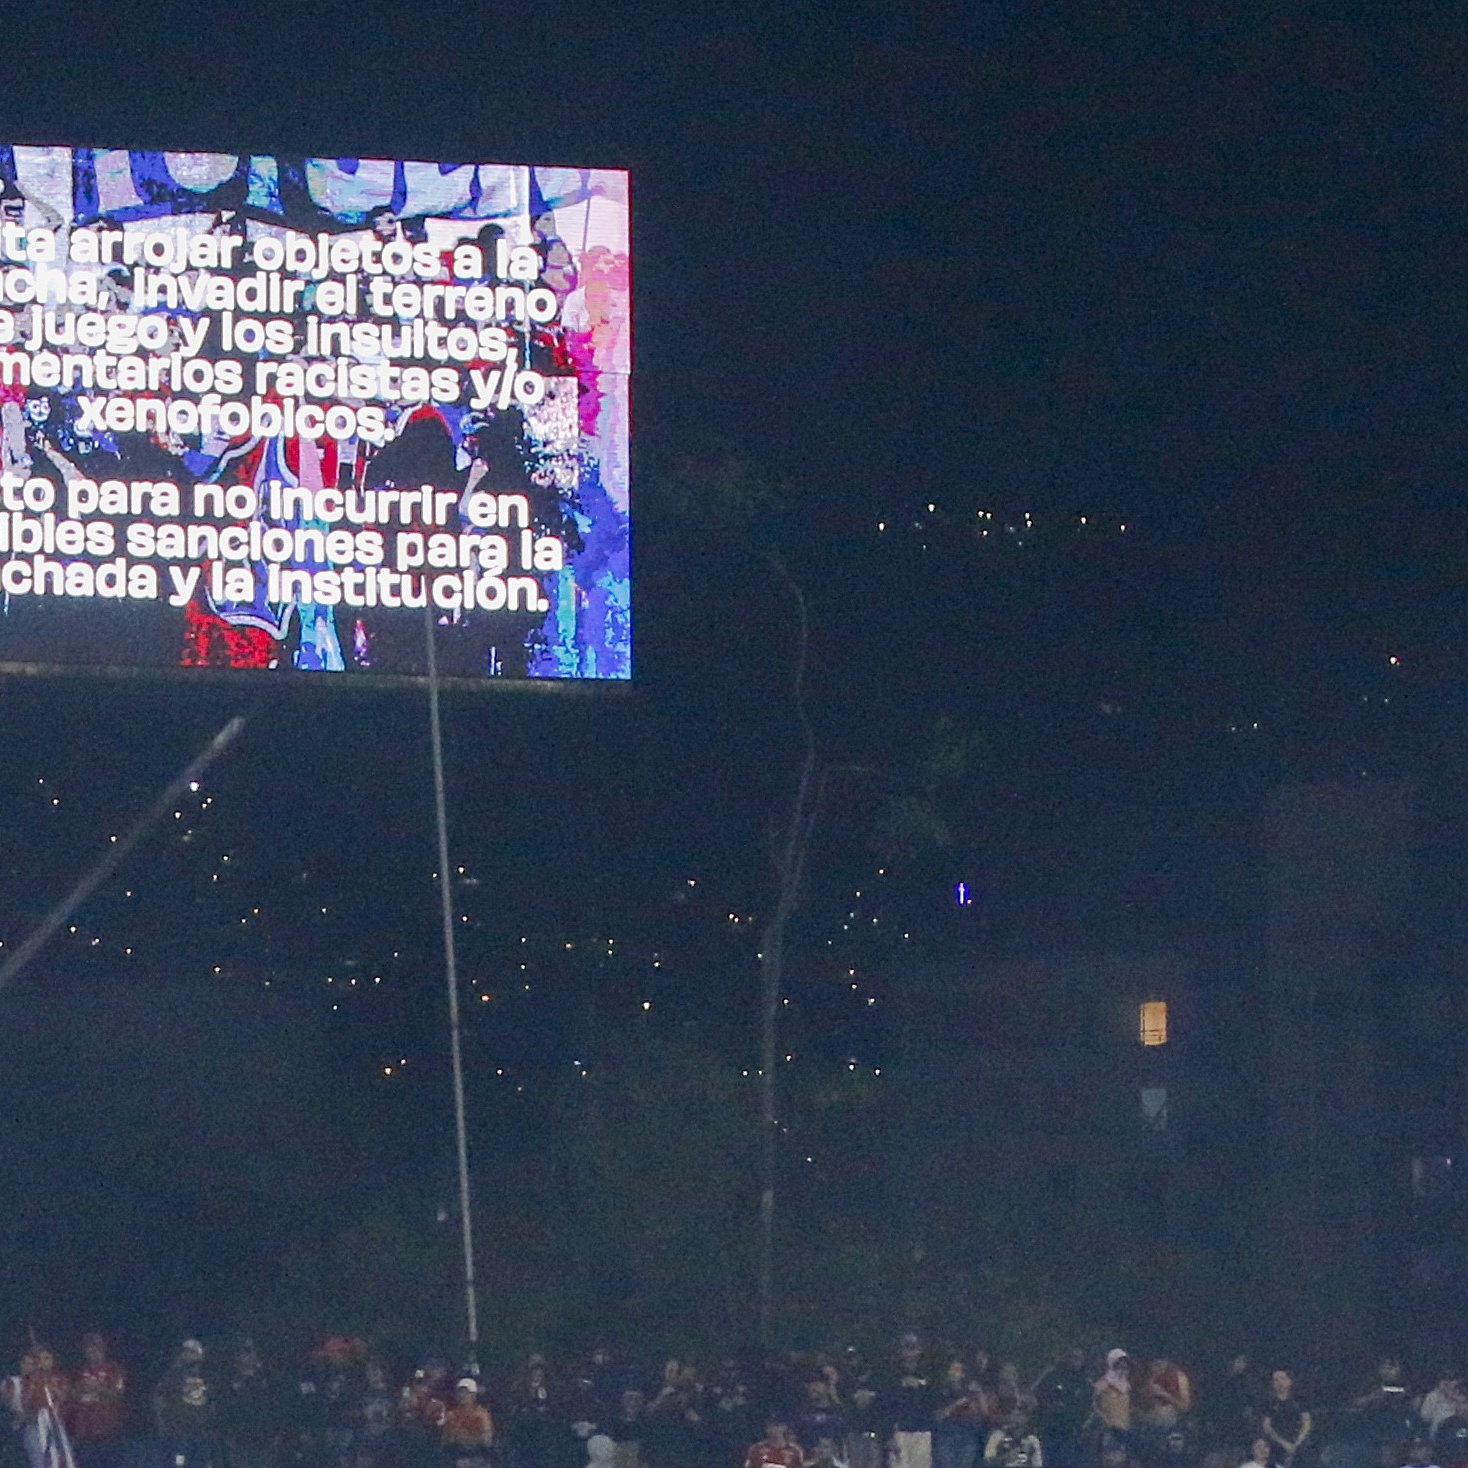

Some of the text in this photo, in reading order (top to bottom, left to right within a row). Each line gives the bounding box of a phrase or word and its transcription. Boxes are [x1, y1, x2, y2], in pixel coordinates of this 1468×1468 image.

[70, 227, 243, 273] arrojar
[253, 230, 441, 279] objetos
[454, 243, 483, 278] a
[496, 238, 539, 280] la
[134, 267, 304, 314] invadir
[315, 274, 357, 316] el
[369, 277, 557, 323] terreno
[25, 305, 167, 353] juego
[178, 317, 210, 357] y
[222, 311, 294, 353] los
[307, 315, 517, 364] insultos,
[256, 358, 460, 402] racistas
[470, 362, 545, 411] y/o
[78, 394, 394, 442] xenofobicos.
[68, 479, 180, 517] para
[194, 482, 256, 519] no
[270, 480, 457, 525] incurrir
[468, 491, 528, 528] en
[127, 521, 384, 565] sanciones
[397, 530, 507, 572] para
[521, 529, 563, 570] la
[169, 565, 201, 607] y
[213, 560, 253, 603] la
[268, 563, 549, 612] institución.
